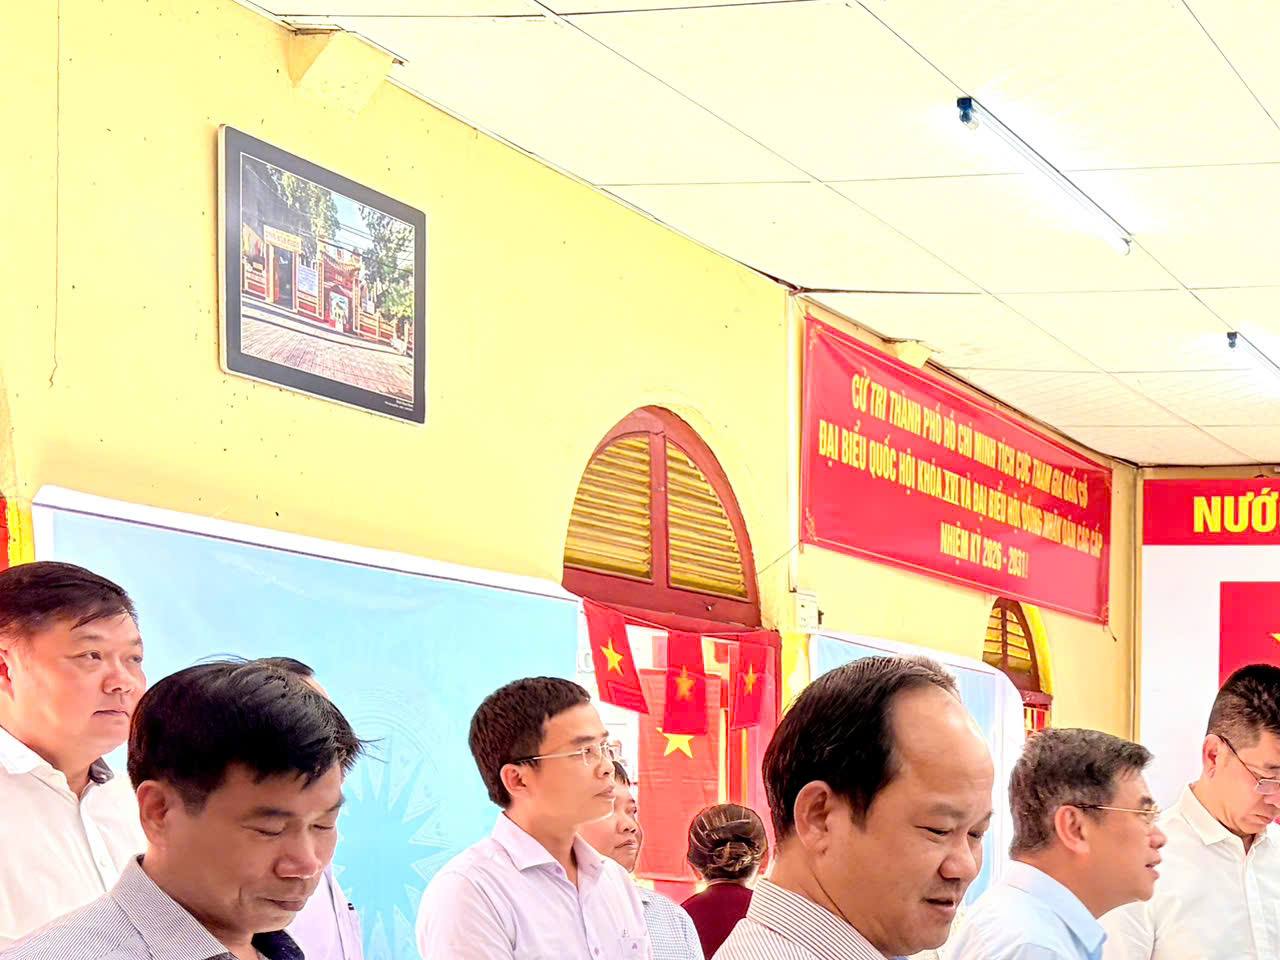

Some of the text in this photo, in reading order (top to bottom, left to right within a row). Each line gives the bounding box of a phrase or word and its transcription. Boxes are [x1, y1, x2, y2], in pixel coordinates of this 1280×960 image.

[852, 366, 870, 412] CỬ
[870, 381, 887, 421] TRI
[889, 390, 921, 435] THÀNH
[923, 402, 942, 445] PHỐ
[958, 421, 973, 459] CHÍ
[974, 431, 996, 469] MINH
[819, 419, 839, 467] ĐẠI
[842, 420, 867, 470] BIỂU
[869, 434, 896, 481] QUỐC
[899, 448, 915, 495] HỘI
[918, 458, 942, 498] KHÓA
[941, 521, 969, 565] NHIỆM
[970, 528, 981, 564] KỲ
[982, 537, 1002, 571] 2026
